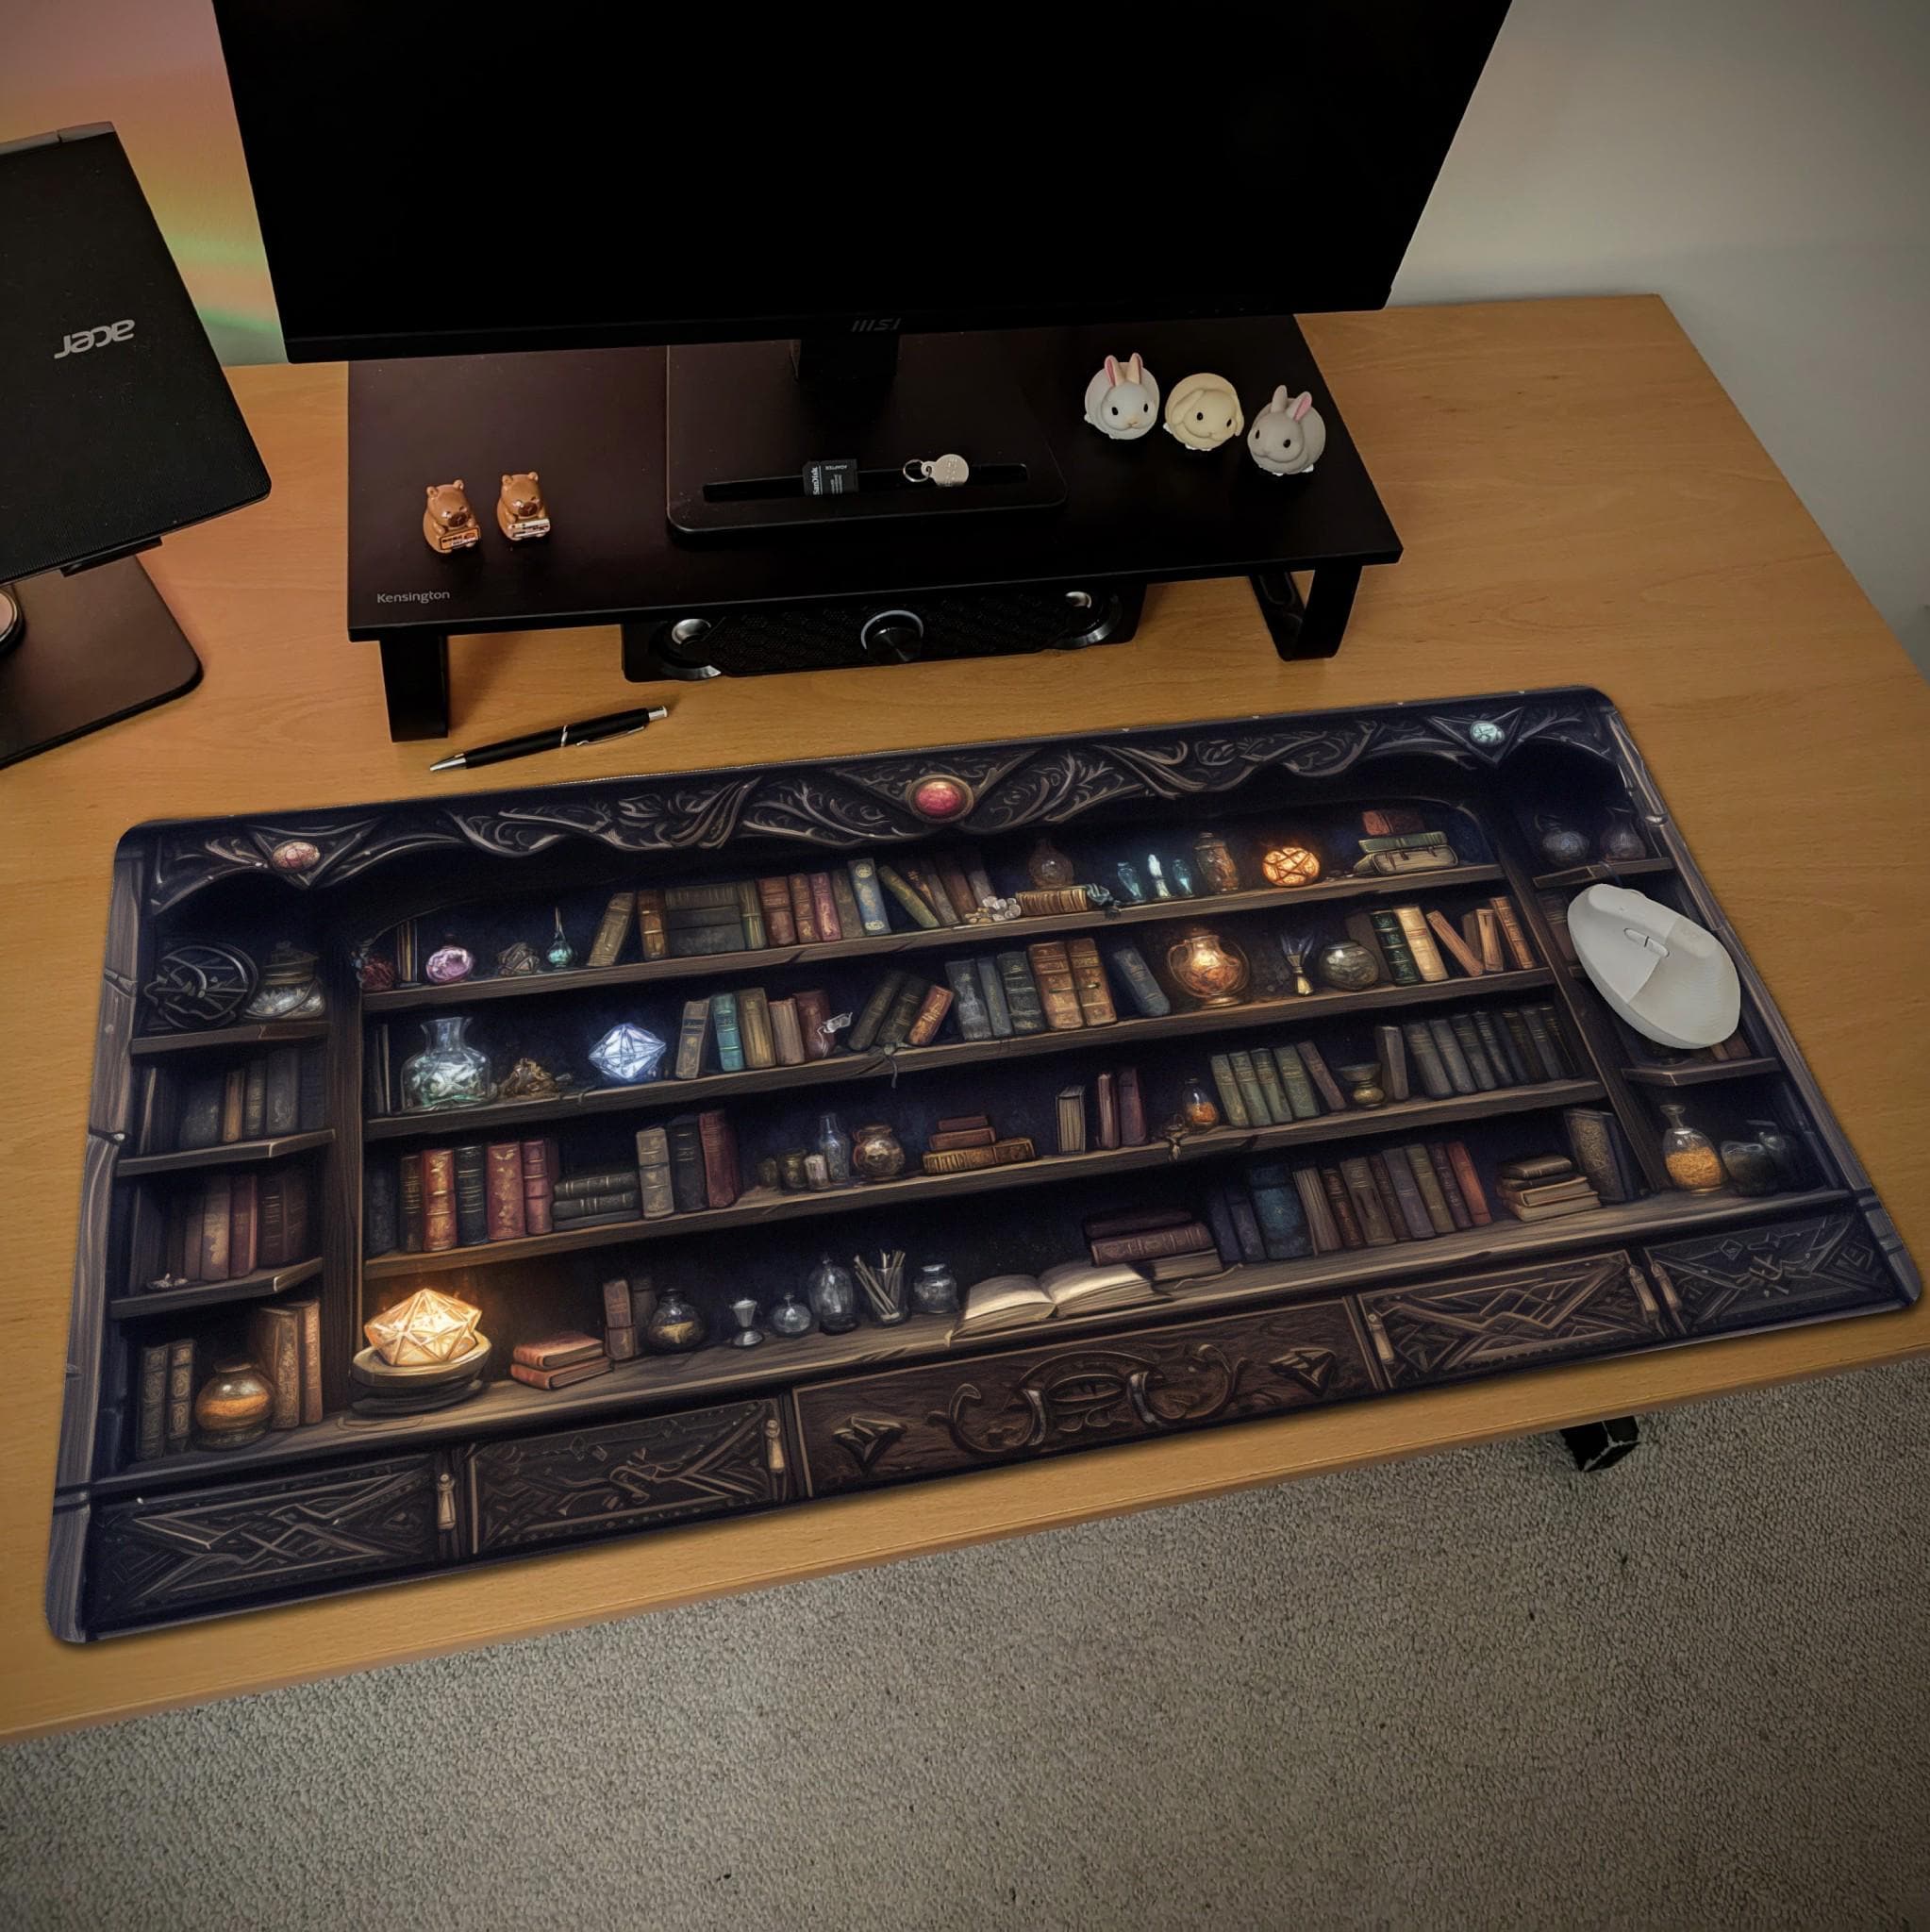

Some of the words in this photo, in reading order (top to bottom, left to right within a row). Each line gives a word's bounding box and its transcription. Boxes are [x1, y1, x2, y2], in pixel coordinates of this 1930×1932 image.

[53, 319, 136, 359] acer
[810, 466, 821, 495] SanDisk
[376, 591, 451, 604] Kensington
